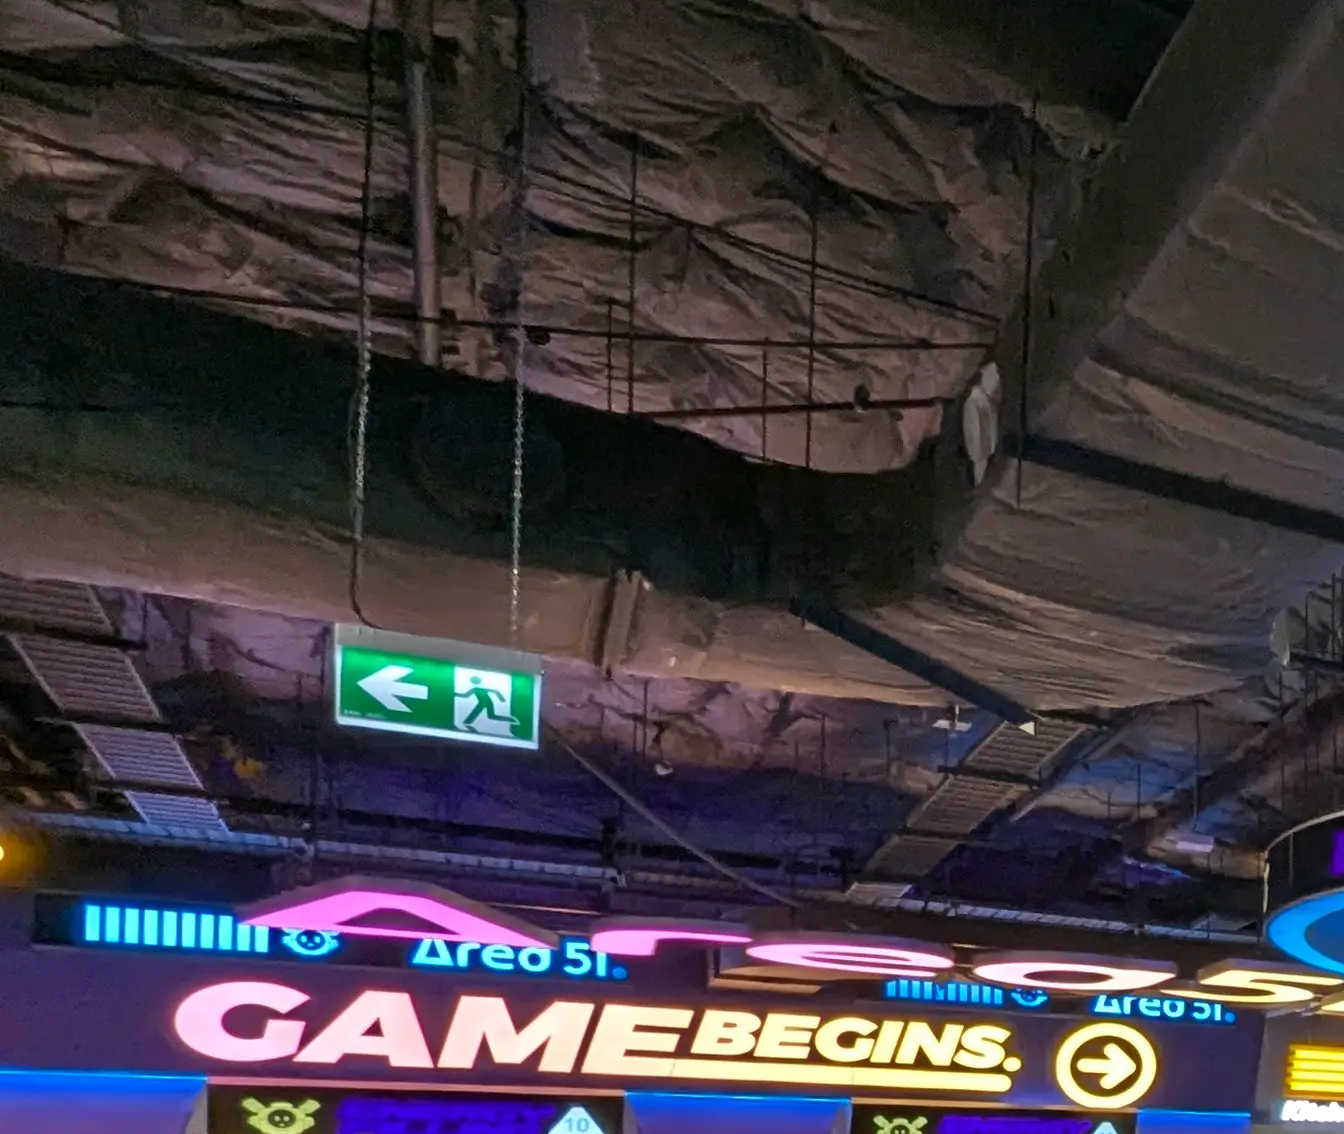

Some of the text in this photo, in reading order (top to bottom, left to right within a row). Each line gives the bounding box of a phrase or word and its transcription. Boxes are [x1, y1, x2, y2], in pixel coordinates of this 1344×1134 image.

[175, 981, 1022, 1077] GAME BEGINS.
[564, 1117, 590, 1133] 10
